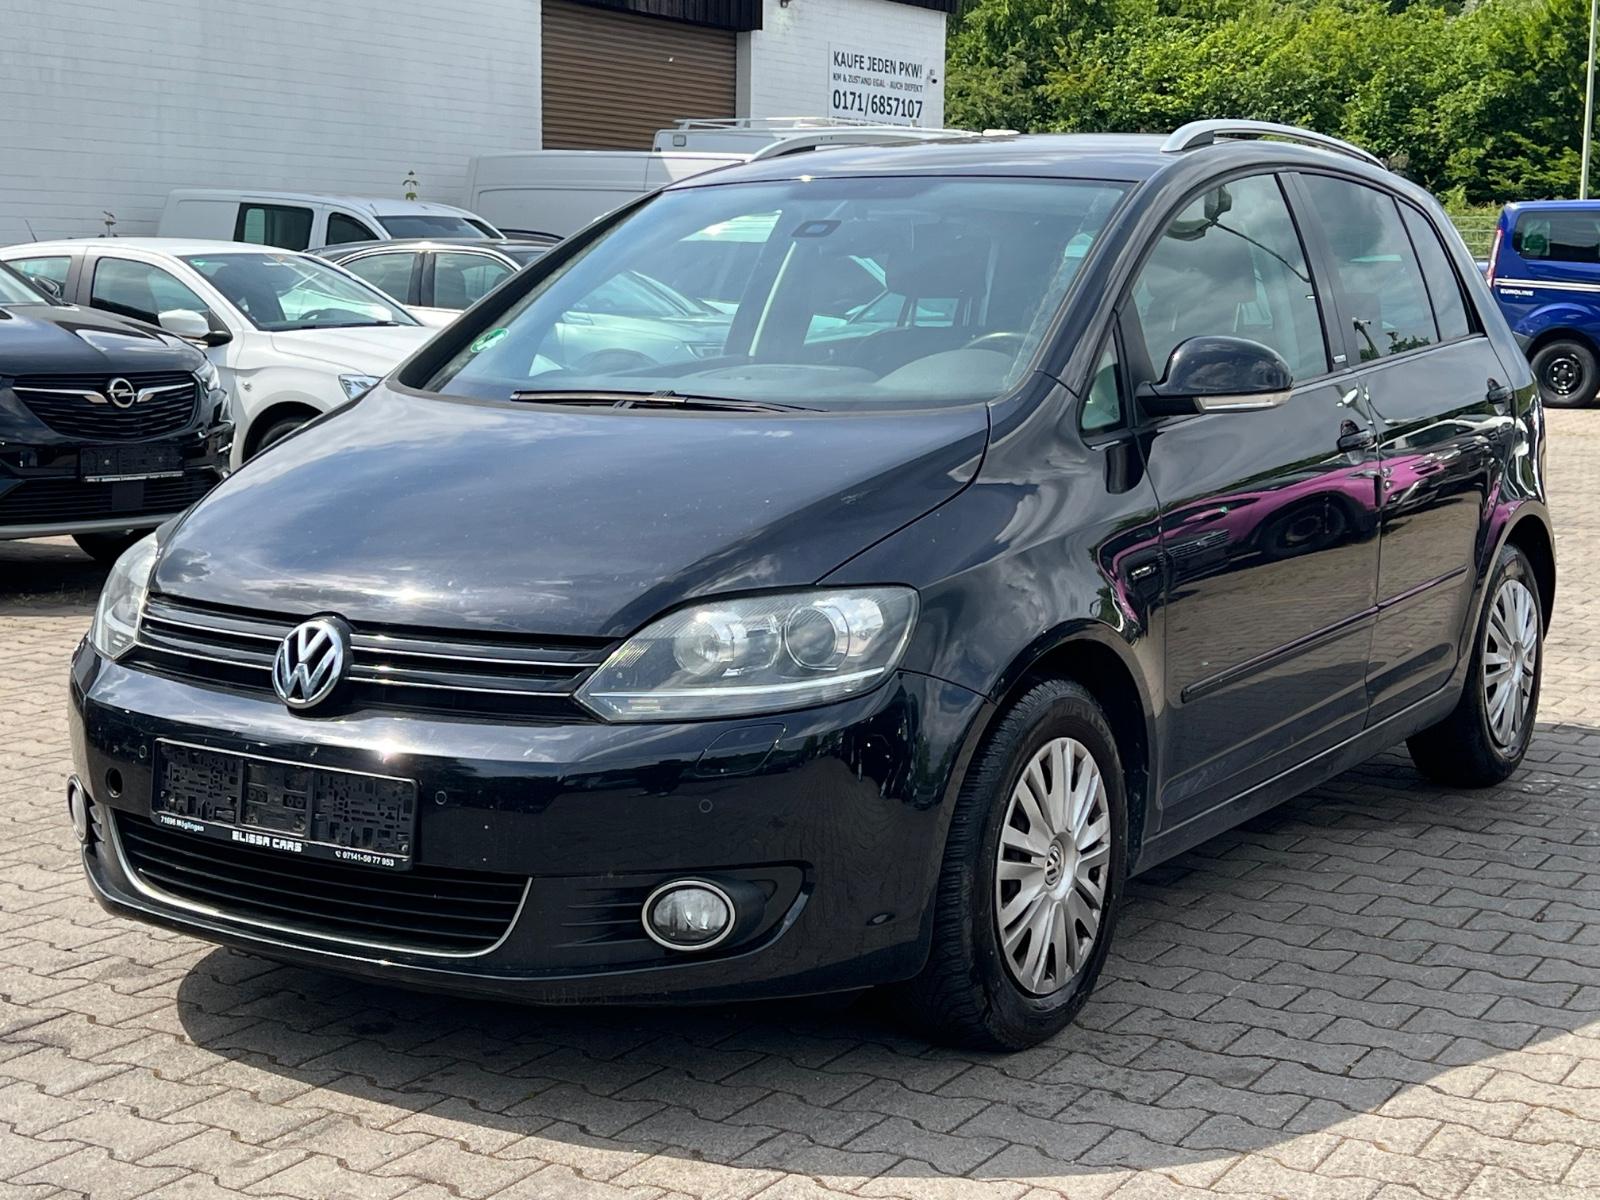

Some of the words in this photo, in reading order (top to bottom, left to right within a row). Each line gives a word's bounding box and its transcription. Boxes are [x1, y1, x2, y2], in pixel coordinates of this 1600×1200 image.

[833, 50, 865, 70] KAUFE
[867, 56, 897, 75] JEDEN
[899, 61, 923, 79] PKW!
[848, 74, 872, 87] ZUSTAND
[873, 78, 886, 88] EGAL
[890, 80, 903, 90] AUCH
[904, 82, 923, 93] DEFEKT
[833, 89, 923, 119] 0171/6857107
[1500, 288, 1534, 297] EUROLINE
[275, 619, 342, 705] VW
[232, 830, 270, 847] ELISSA
[272, 838, 302, 853] CARS
[372, 856, 381, 865] 77
